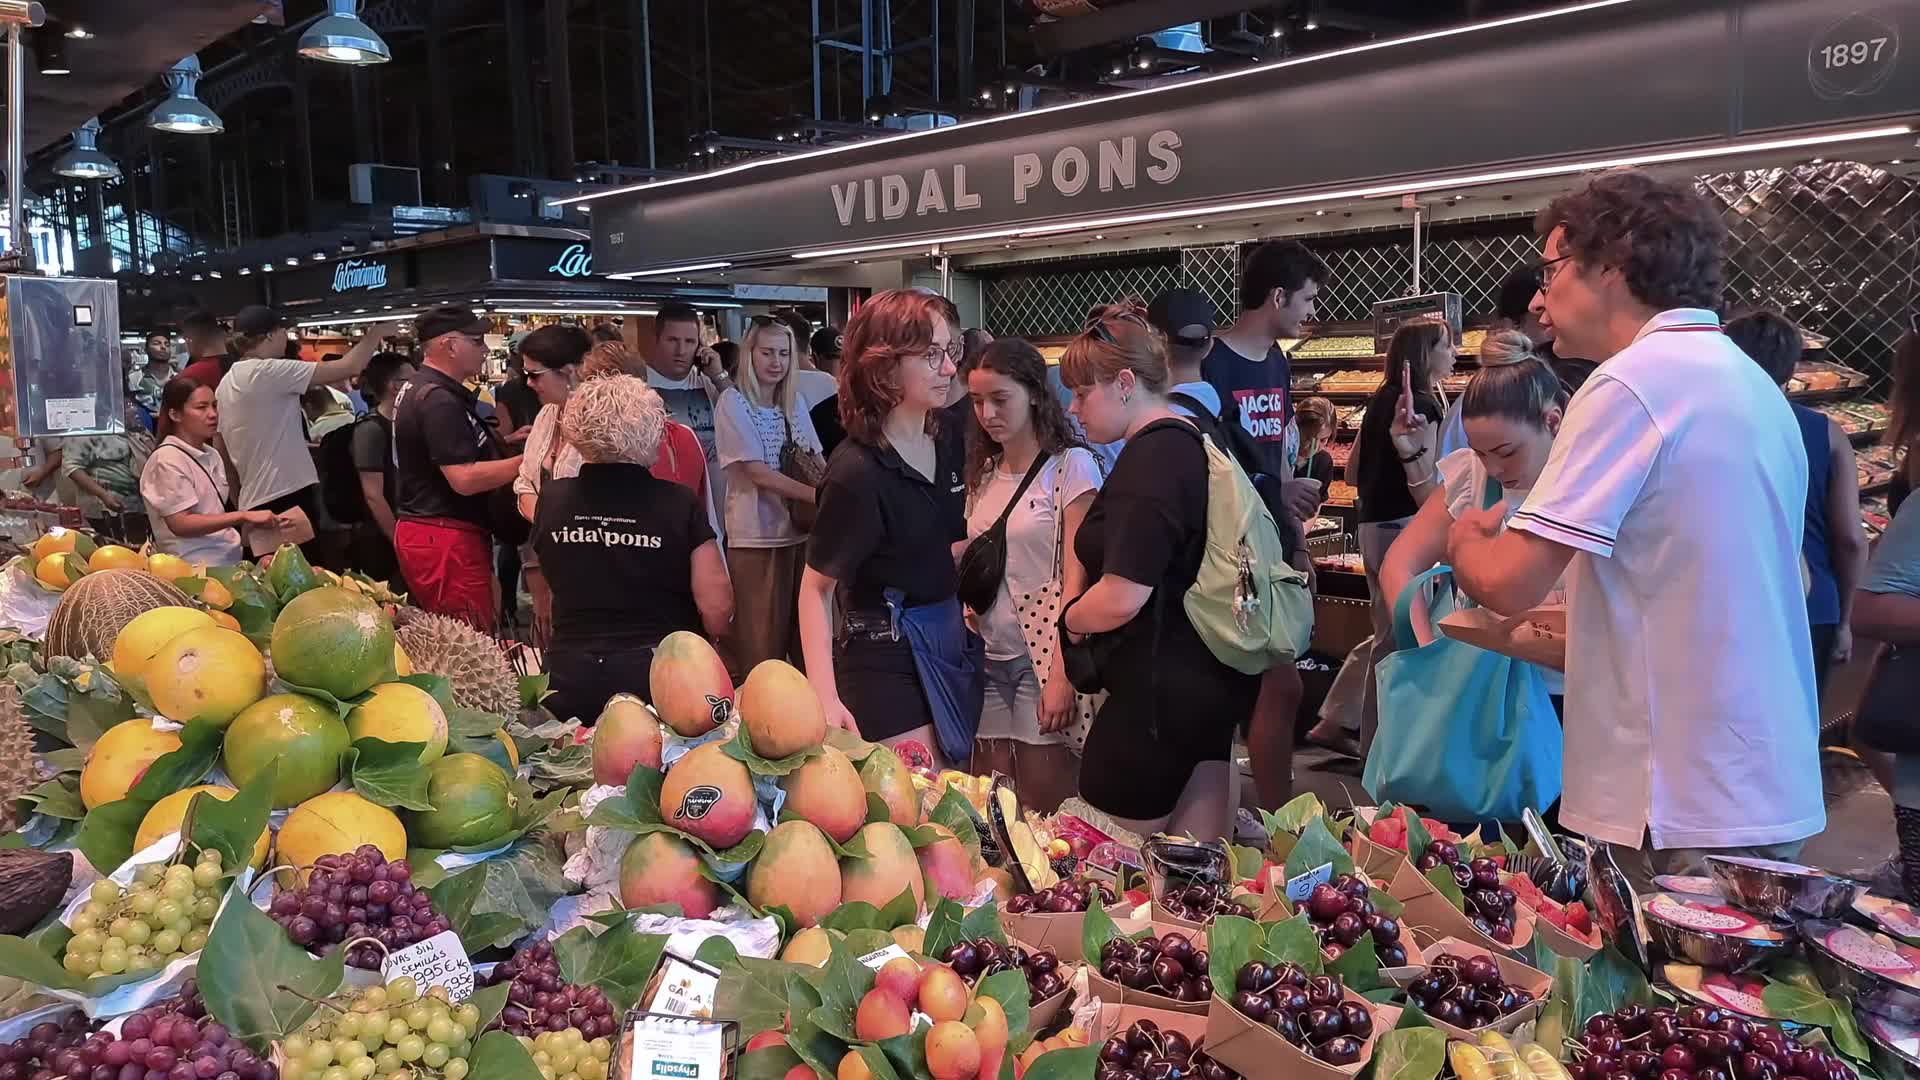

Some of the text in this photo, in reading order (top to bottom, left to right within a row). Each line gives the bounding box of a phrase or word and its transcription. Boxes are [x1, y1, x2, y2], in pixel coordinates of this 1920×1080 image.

[1821, 38, 1887, 69] 1897
[831, 130, 1182, 226] VIDAL PONS
